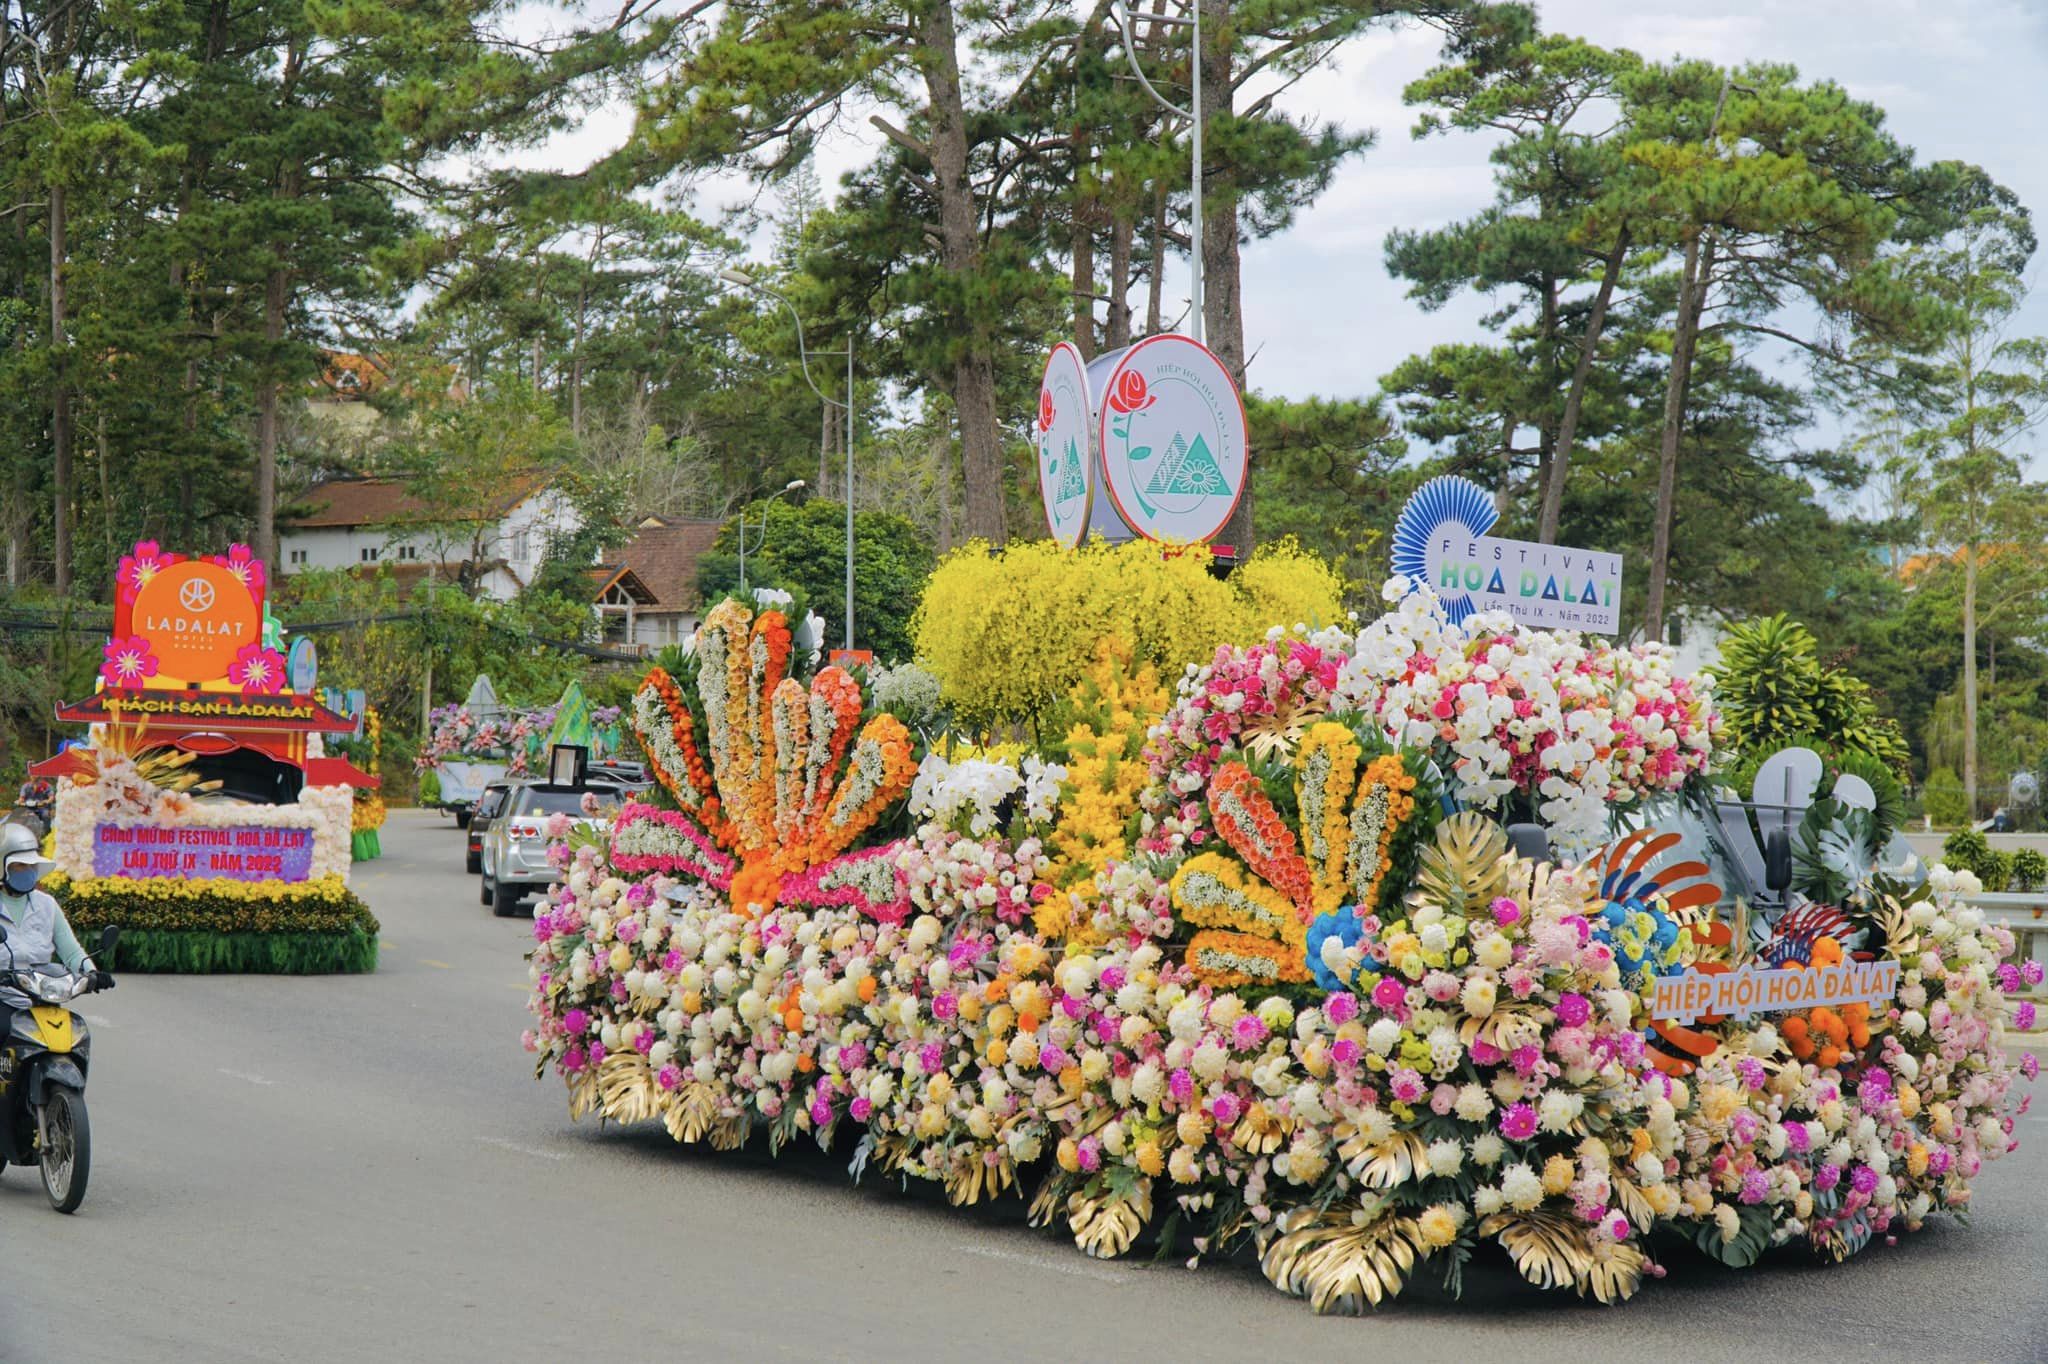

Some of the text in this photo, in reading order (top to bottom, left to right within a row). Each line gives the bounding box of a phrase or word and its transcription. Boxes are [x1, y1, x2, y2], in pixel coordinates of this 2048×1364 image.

[1442, 539, 1617, 576] FESTIVAL
[1440, 559, 1617, 608] HOA DALAT
[147, 615, 243, 637] LADALAT
[1534, 607, 1544, 617] IX
[1586, 612, 1609, 625] 2022
[102, 695, 314, 719] KHÁCH SẠN LADALAT
[178, 829, 232, 847] FESTIVAL
[236, 831, 260, 847] HOA
[183, 853, 196, 869] IX
[210, 853, 241, 870] NĂM
[246, 856, 282, 873] 2022
[1656, 966, 1897, 1018] HIỆP HỘI HOA ĐÀ LẠT
